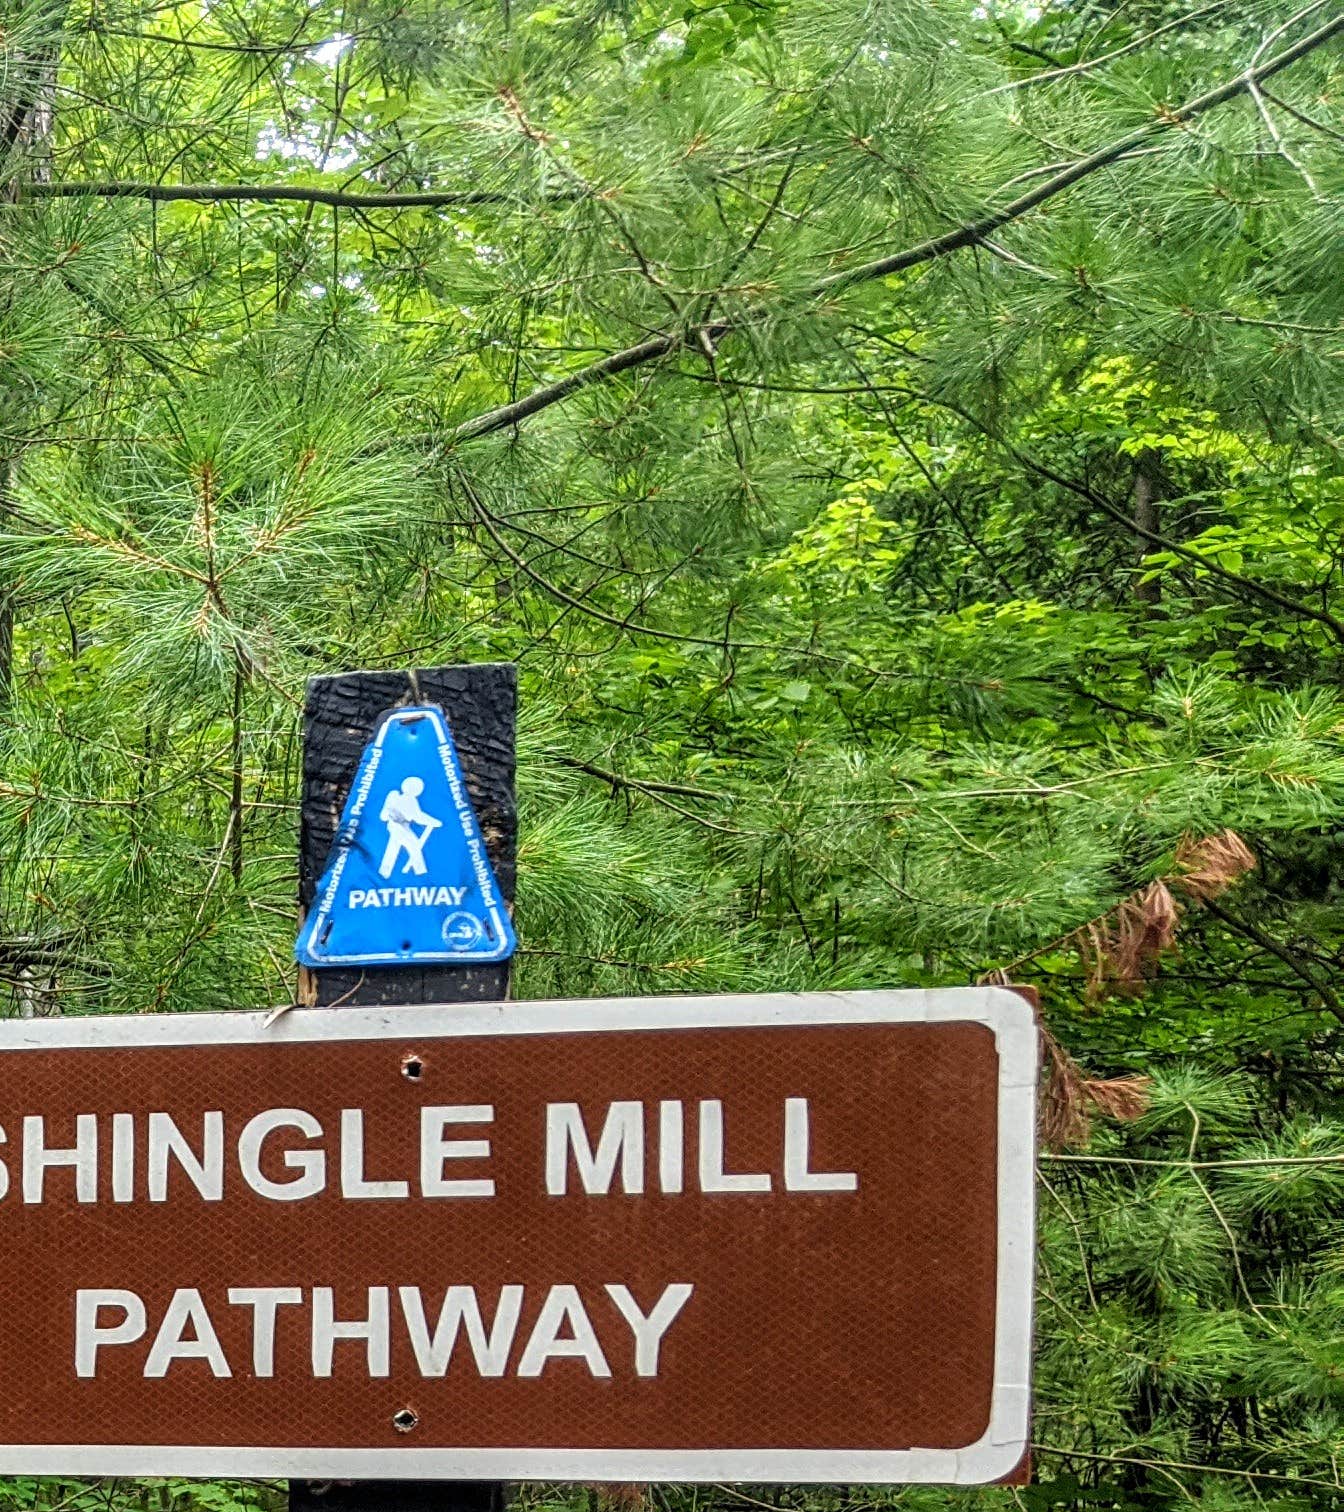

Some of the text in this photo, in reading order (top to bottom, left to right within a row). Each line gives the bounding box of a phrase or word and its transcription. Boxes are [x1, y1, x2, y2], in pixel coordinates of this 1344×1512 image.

[353, 747, 383, 816] Prohibited
[437, 744, 497, 908] Motorized Use Prohibited
[349, 886, 467, 909] PATHWAY
[544, 1097, 858, 1195] MILL
[75, 1283, 693, 1379] PATHWAY
